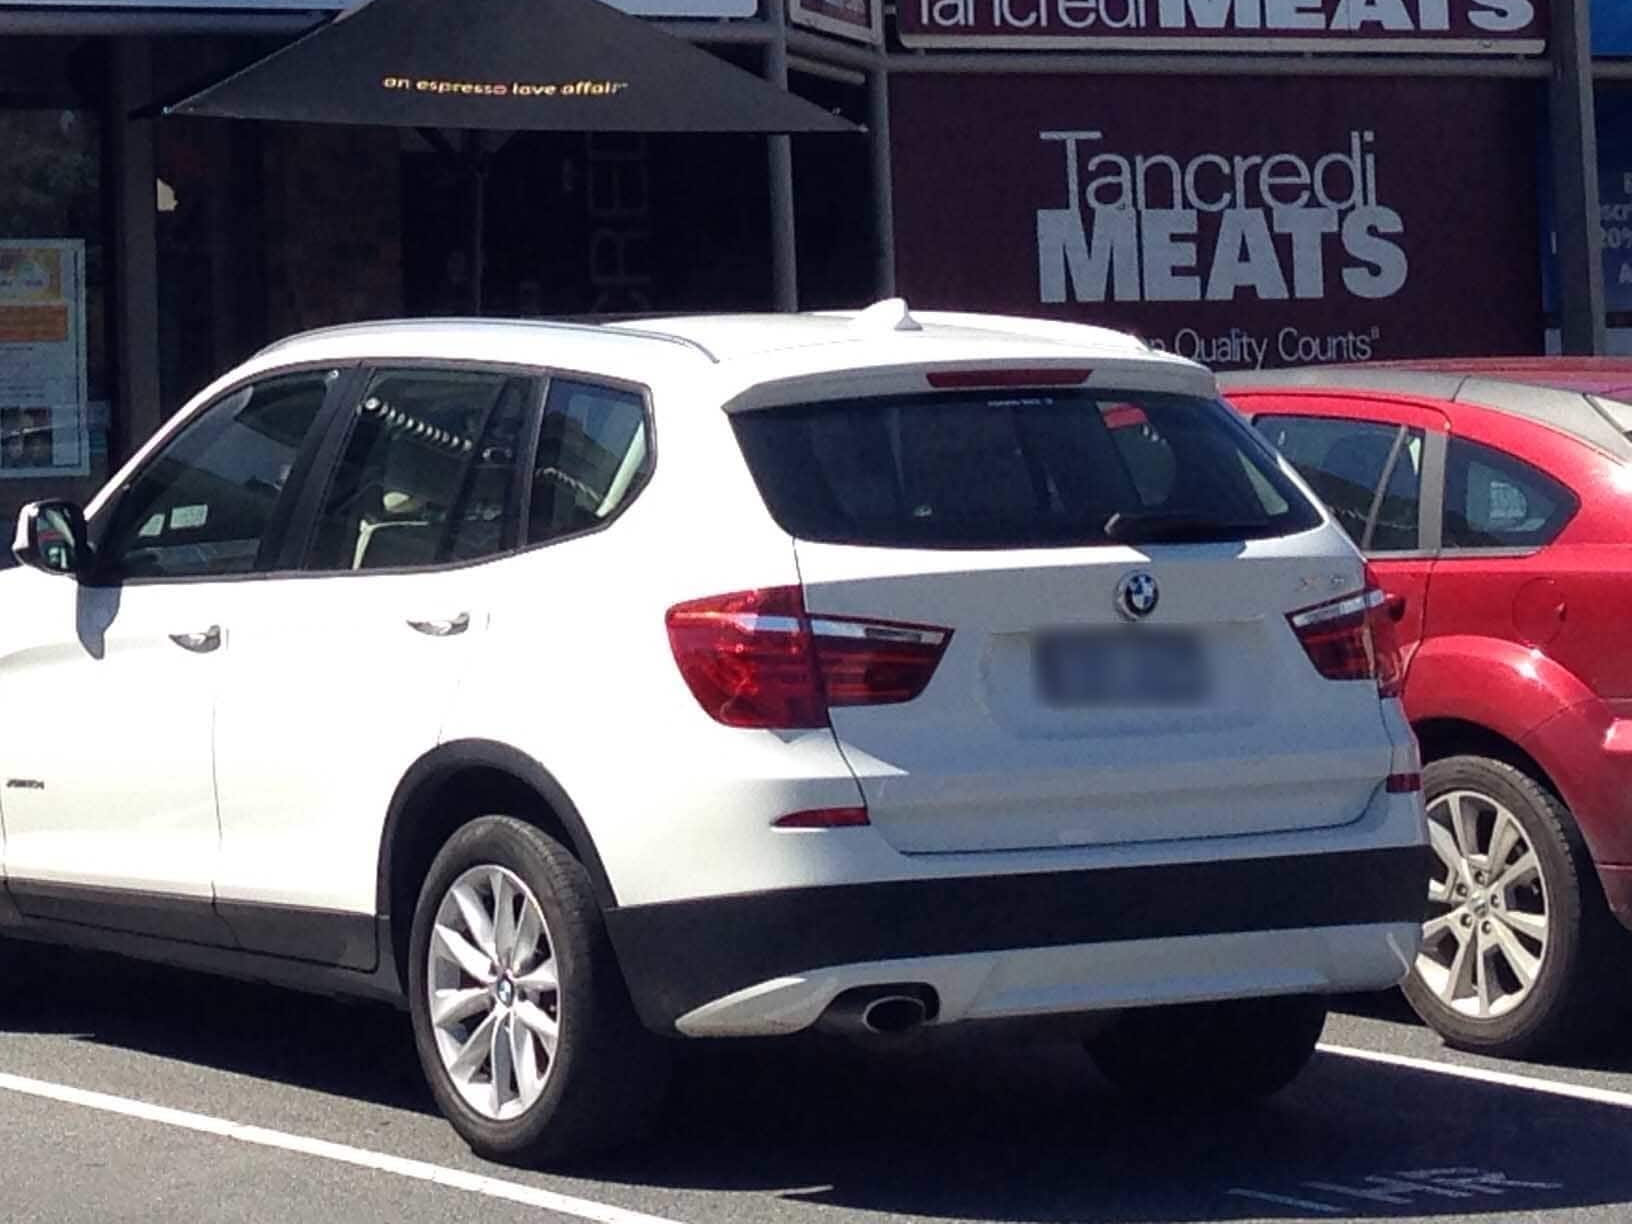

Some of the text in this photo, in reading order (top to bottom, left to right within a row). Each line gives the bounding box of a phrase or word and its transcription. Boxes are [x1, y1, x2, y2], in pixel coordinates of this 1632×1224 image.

[415, 78, 508, 95] espresso
[512, 80, 557, 96] love
[1039, 130, 1377, 212] Tancredi
[1036, 206, 1409, 303] MEATS
[1174, 327, 1269, 370] Quality
